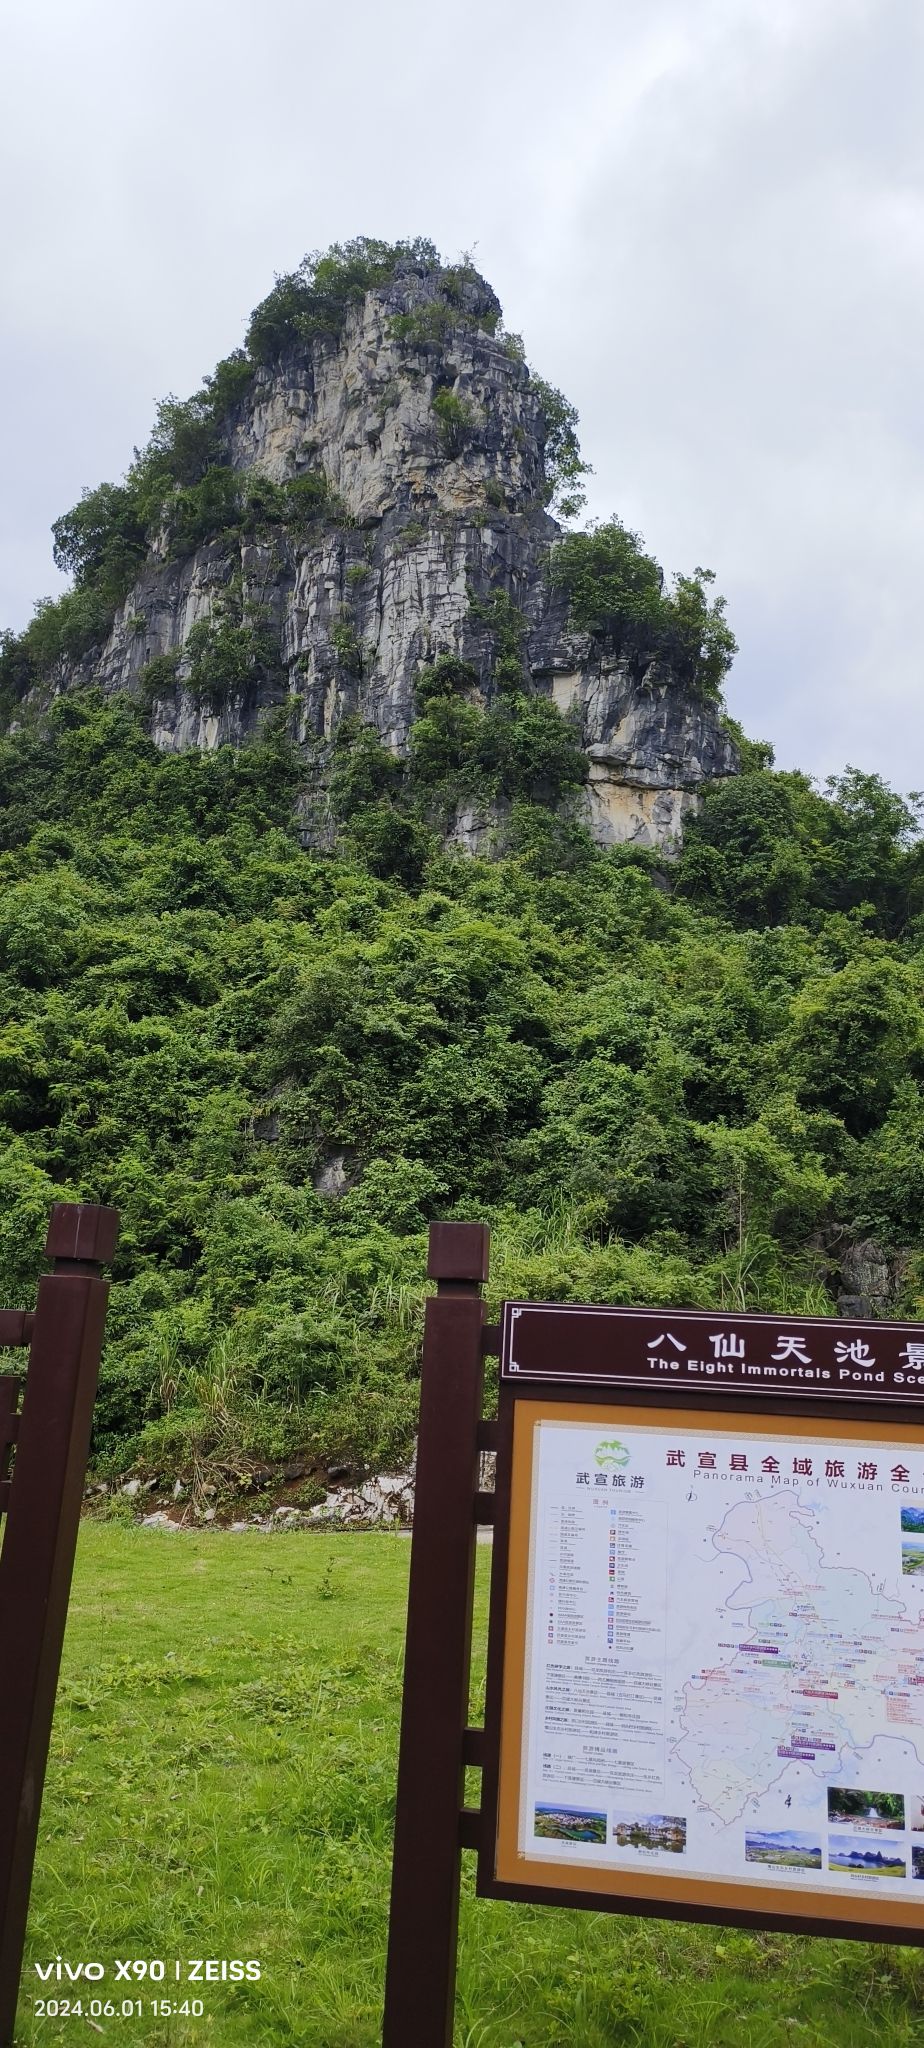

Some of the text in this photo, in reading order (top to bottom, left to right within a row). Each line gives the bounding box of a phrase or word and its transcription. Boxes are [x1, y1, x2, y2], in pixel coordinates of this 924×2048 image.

[646, 1333, 924, 1371] 八仙天池景
[646, 1357, 924, 1385] The Eight Immortals Pond Sce
[666, 1449, 924, 1483] 武宣县全域旅游全
[576, 1472, 645, 1489] 武宣旅游
[693, 1469, 764, 1483] Panorama
[771, 1475, 800, 1488] Map
[806, 1477, 820, 1487] of
[828, 1479, 883, 1492] Wuxuan
